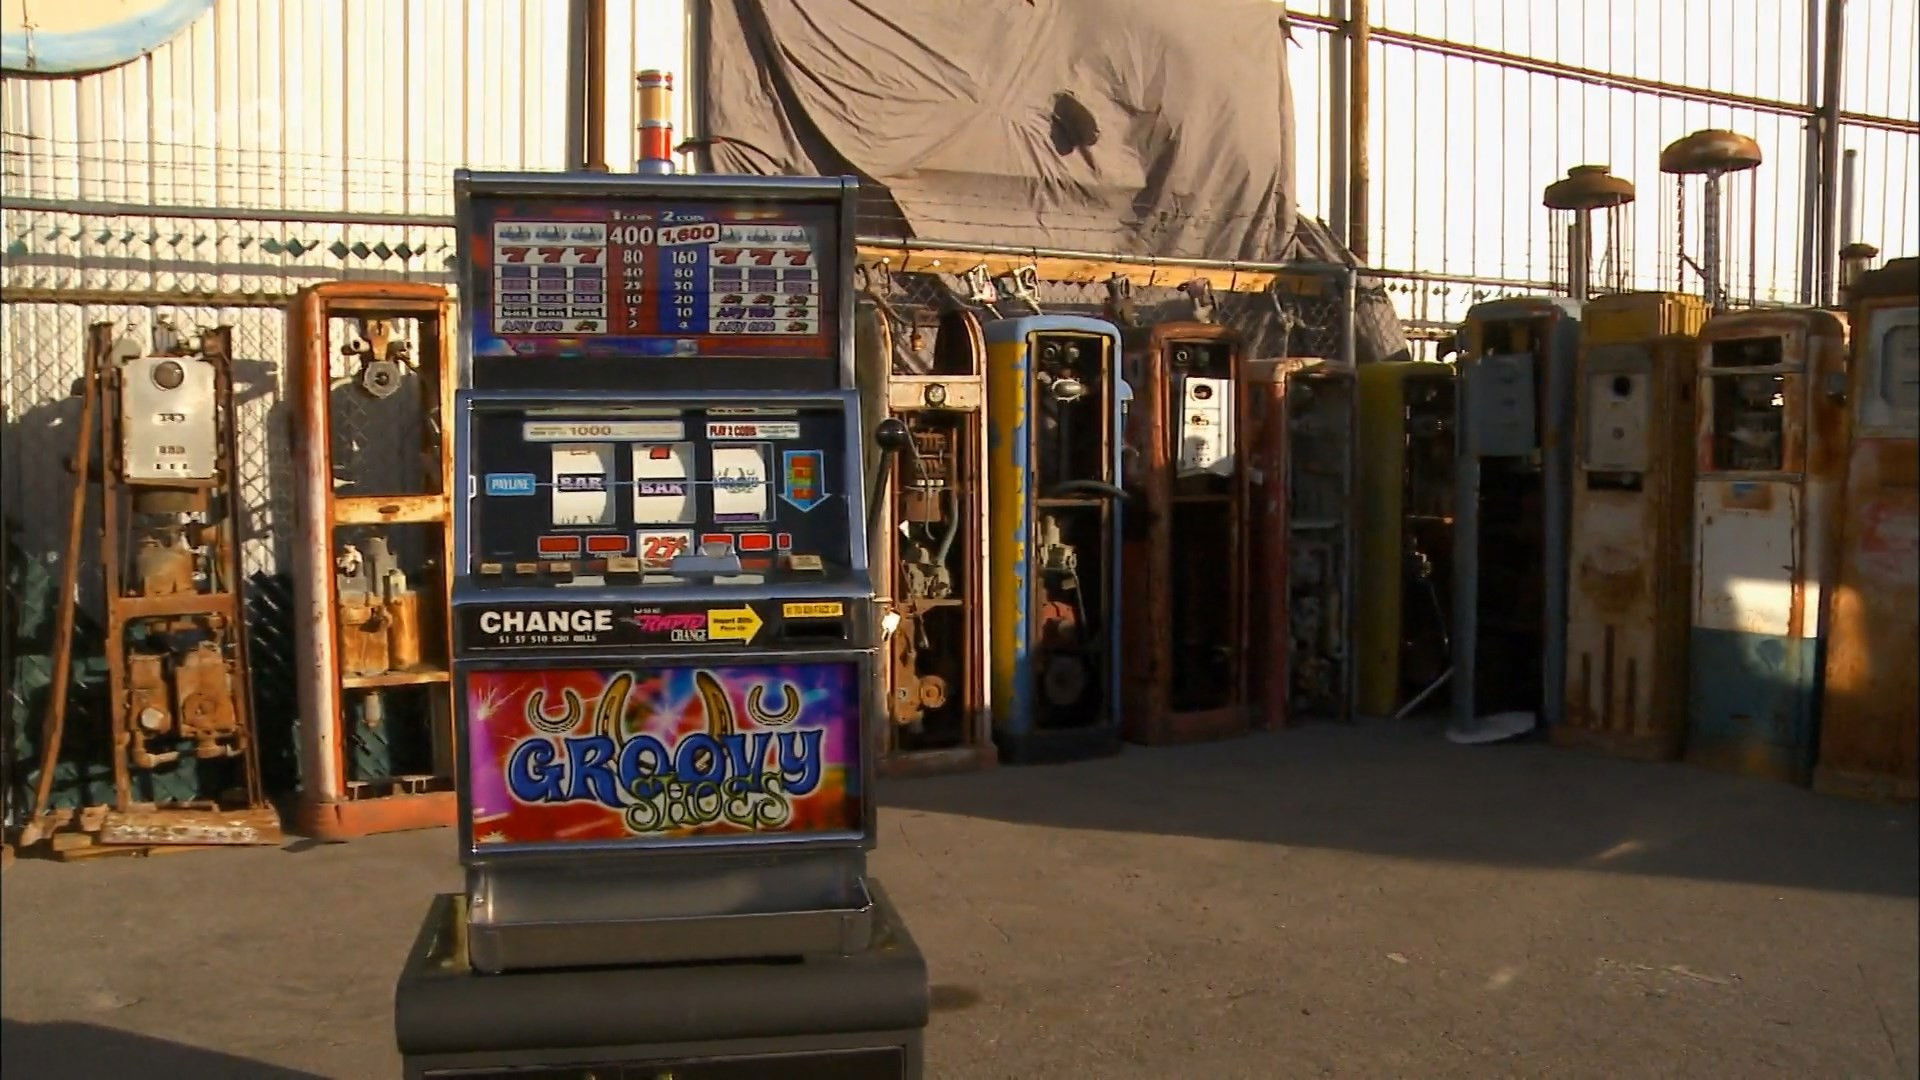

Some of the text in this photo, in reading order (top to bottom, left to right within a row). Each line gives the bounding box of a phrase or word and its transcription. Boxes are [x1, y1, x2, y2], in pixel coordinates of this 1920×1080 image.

[662, 210, 674, 221] 2
[610, 225, 654, 245] 400
[662, 225, 715, 243] 1,600
[623, 249, 643, 264] 80
[672, 250, 697, 264] 160
[623, 267, 643, 278] 40
[673, 281, 693, 291] 50
[626, 295, 642, 304] 10
[673, 295, 694, 304] 20
[677, 307, 693, 317] 10
[569, 425, 611, 436] 1000
[491, 478, 530, 490] PAYLINE
[559, 476, 605, 490] BAR
[640, 483, 684, 495] BAR
[480, 609, 613, 634] CHANGE
[670, 628, 707, 642] CHANGE
[508, 729, 824, 808] GROOVY
[625, 770, 790, 831] SHOES
